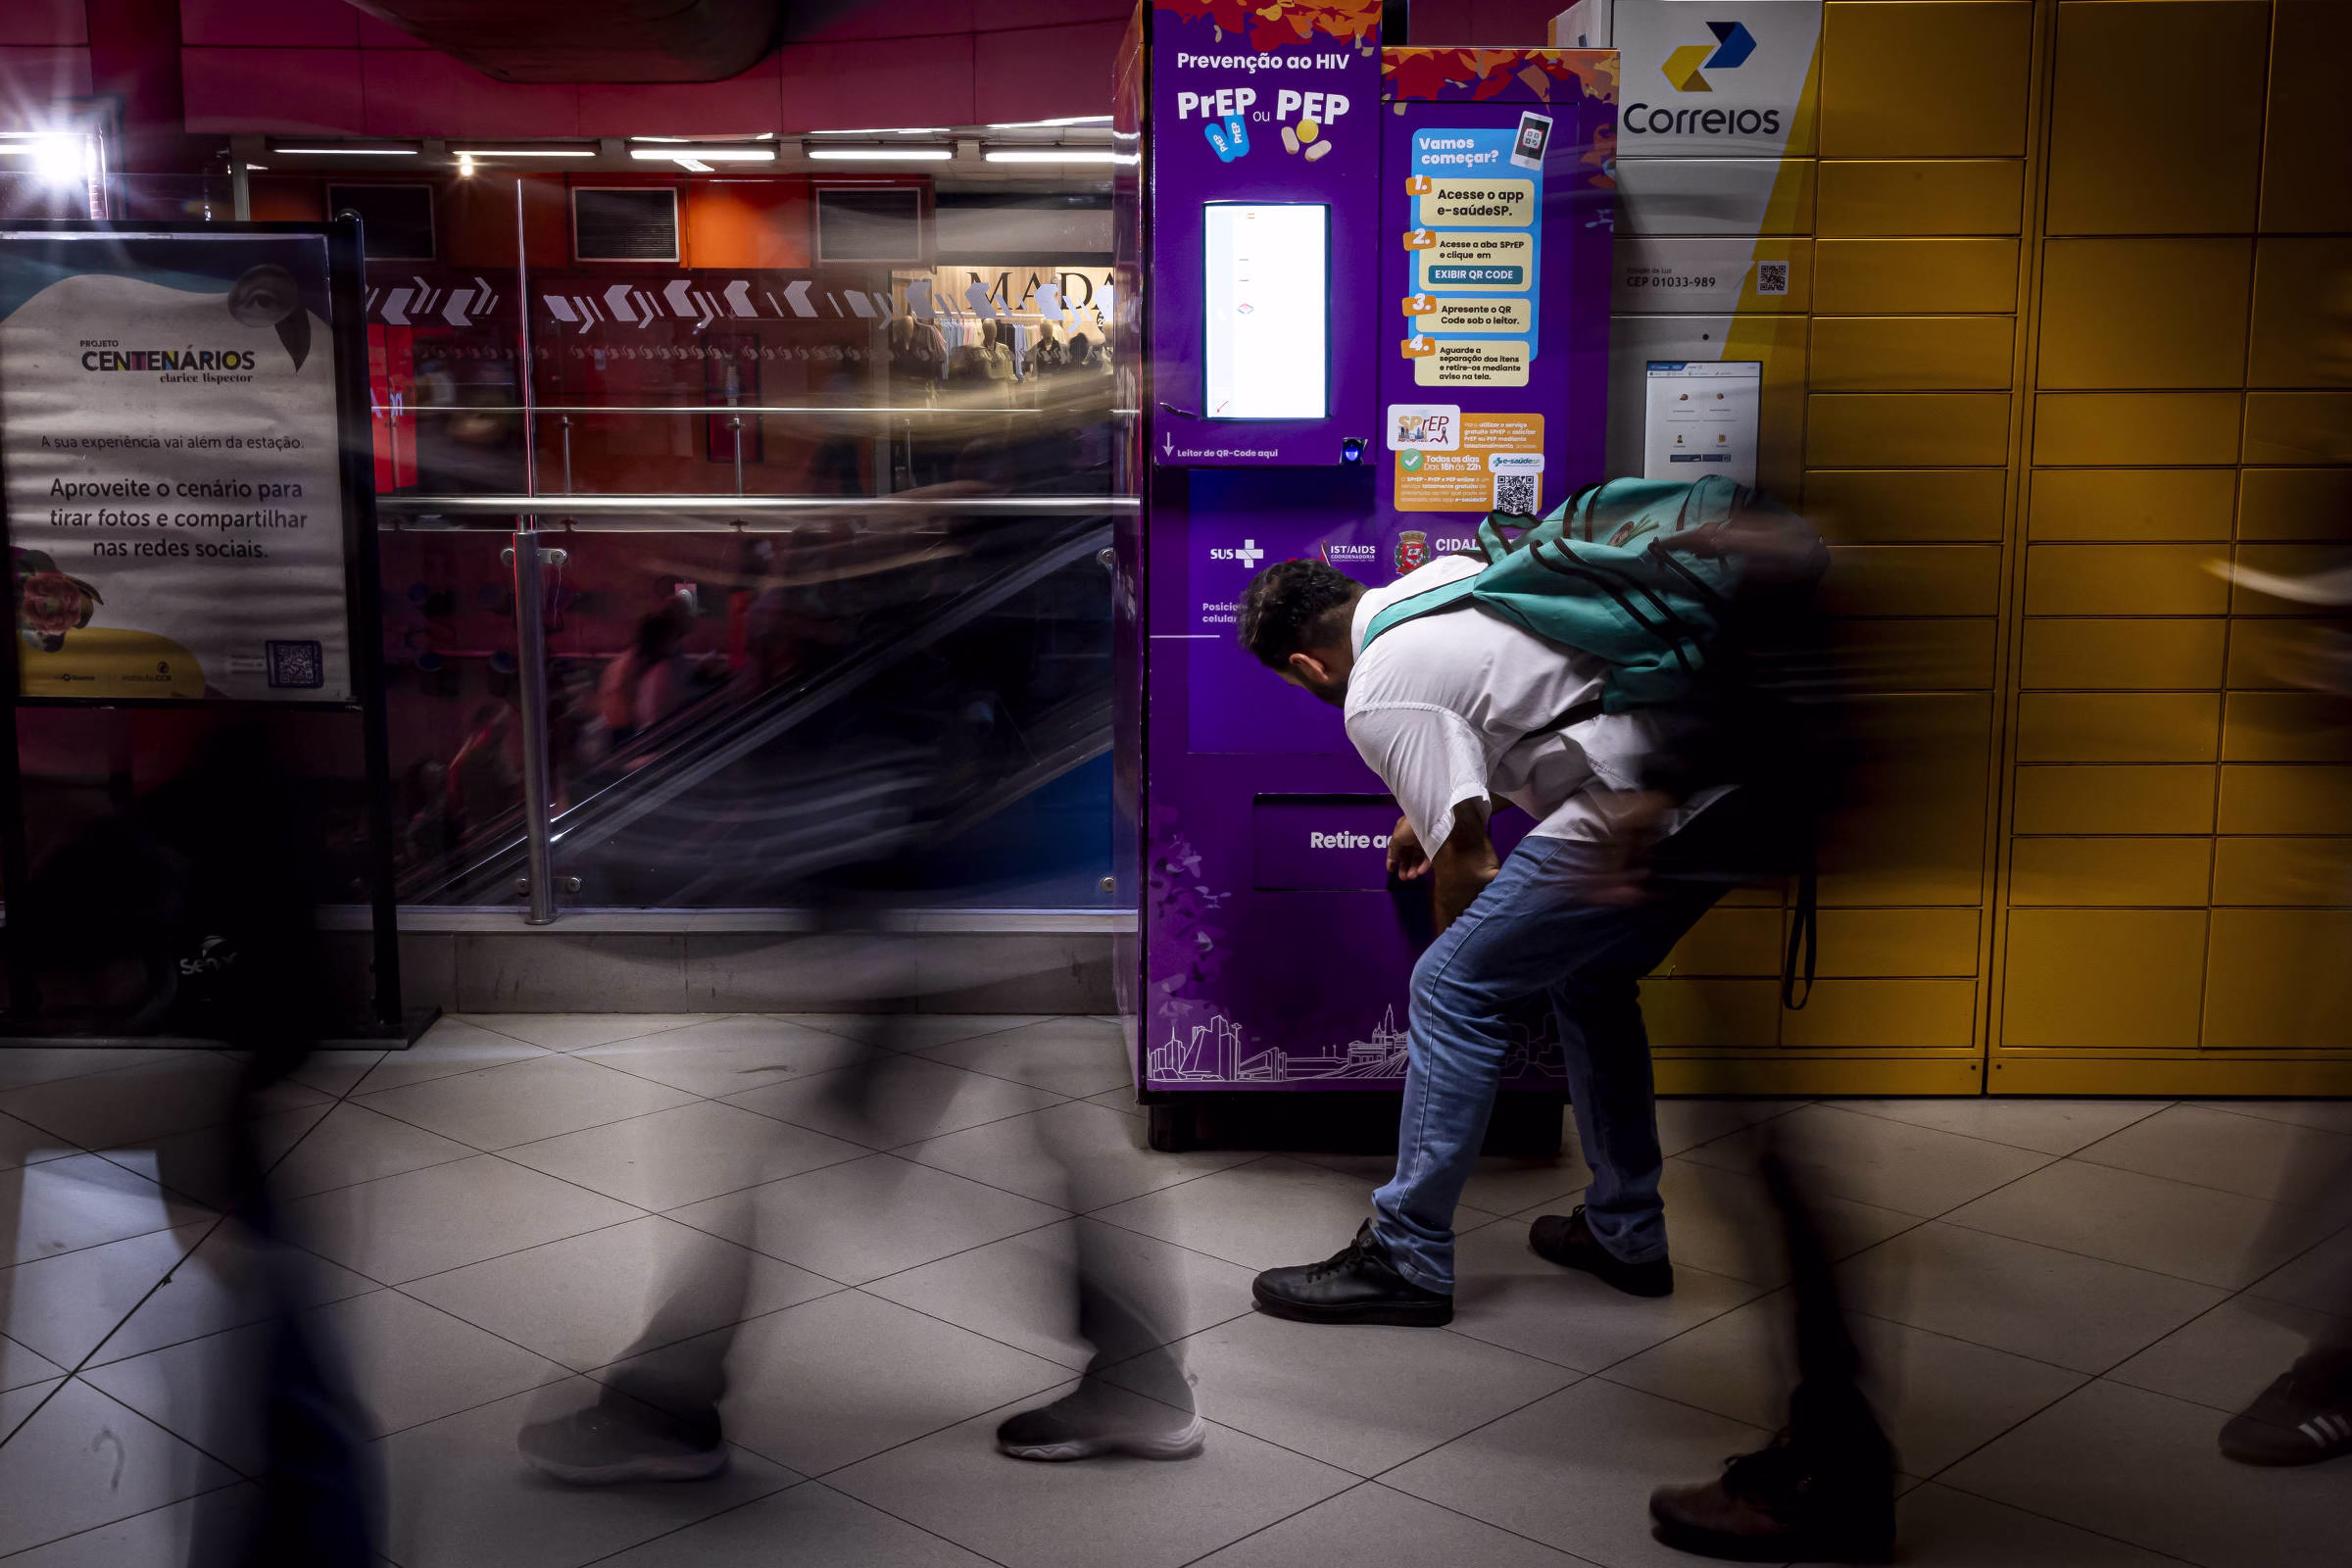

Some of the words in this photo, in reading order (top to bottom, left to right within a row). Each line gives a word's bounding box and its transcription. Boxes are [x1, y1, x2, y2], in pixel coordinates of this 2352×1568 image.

[1177, 52, 1283, 74] Prevenção
[1287, 56, 1312, 70] ao
[1316, 54, 1350, 70] HIV
[1177, 87, 1257, 120] PrEP
[1252, 111, 1270, 122] ou
[1276, 88, 1350, 124] PEP
[1623, 103, 1781, 134] Correios
[1231, 122, 1243, 144] PrEP
[1419, 137, 1475, 150] Vamos
[1421, 150, 1499, 168] começar?
[1414, 174, 1428, 191] 1.
[1438, 189, 1485, 200] Acesse
[1487, 192, 1495, 200] o
[1497, 191, 1524, 204] app
[1437, 204, 1513, 217] e-saúdeSP.
[1413, 227, 1431, 245] 2.
[1440, 241, 1471, 249] Acesse
[1480, 241, 1498, 249] aba
[1446, 251, 1474, 261] clique
[1435, 270, 1468, 279] EXIBIR
[1469, 270, 1484, 280] QR
[1485, 270, 1514, 279] CODE
[1627, 276, 1649, 287] CEP
[1652, 276, 1716, 287] 01033-989
[1412, 293, 1432, 311] 3.
[1441, 306, 1489, 315] Apresente
[1498, 306, 1512, 314] QR
[1467, 316, 1484, 324] sob
[1494, 317, 1520, 325] leitor.
[79, 340, 120, 348] PROJETO
[1409, 334, 1430, 351] 4.
[81, 344, 255, 371] CENTENÁRIOS
[1440, 347, 1474, 356] Aguarde
[1440, 355, 1482, 364] separação
[159, 374, 199, 383] clarice
[203, 373, 253, 385] lispector
[1397, 416, 1449, 432] SPrEP
[41, 436, 51, 448] A
[54, 439, 77, 449] sua
[81, 435, 160, 452] experiência
[164, 436, 184, 449] vai
[188, 435, 221, 449] além
[225, 436, 243, 449] da
[246, 437, 305, 452] estação.
[1177, 449, 1202, 458] Leitor
[1203, 449, 1216, 458] de
[1216, 449, 1257, 458] QR-Code
[1258, 449, 1278, 460] aqui
[1426, 455, 1450, 464] Todos
[1462, 454, 1480, 464] dias
[1441, 463, 1454, 471] 18h
[1466, 463, 1481, 471] 22h
[50, 479, 150, 501] Aproveite
[157, 483, 170, 498] o
[177, 479, 252, 498] cenário
[258, 483, 303, 501] para
[50, 509, 93, 526] tirar
[98, 509, 150, 527] fotos
[157, 514, 169, 527] e
[174, 509, 308, 532] compartilhar
[93, 542, 127, 557] nas
[134, 539, 190, 557] redes
[196, 539, 269, 559] sociais.
[1210, 548, 1234, 560] SUS
[1330, 545, 1376, 554] IST/AIDS
[1202, 602, 1240, 612] Posicio
[1310, 831, 1371, 849] Retire
